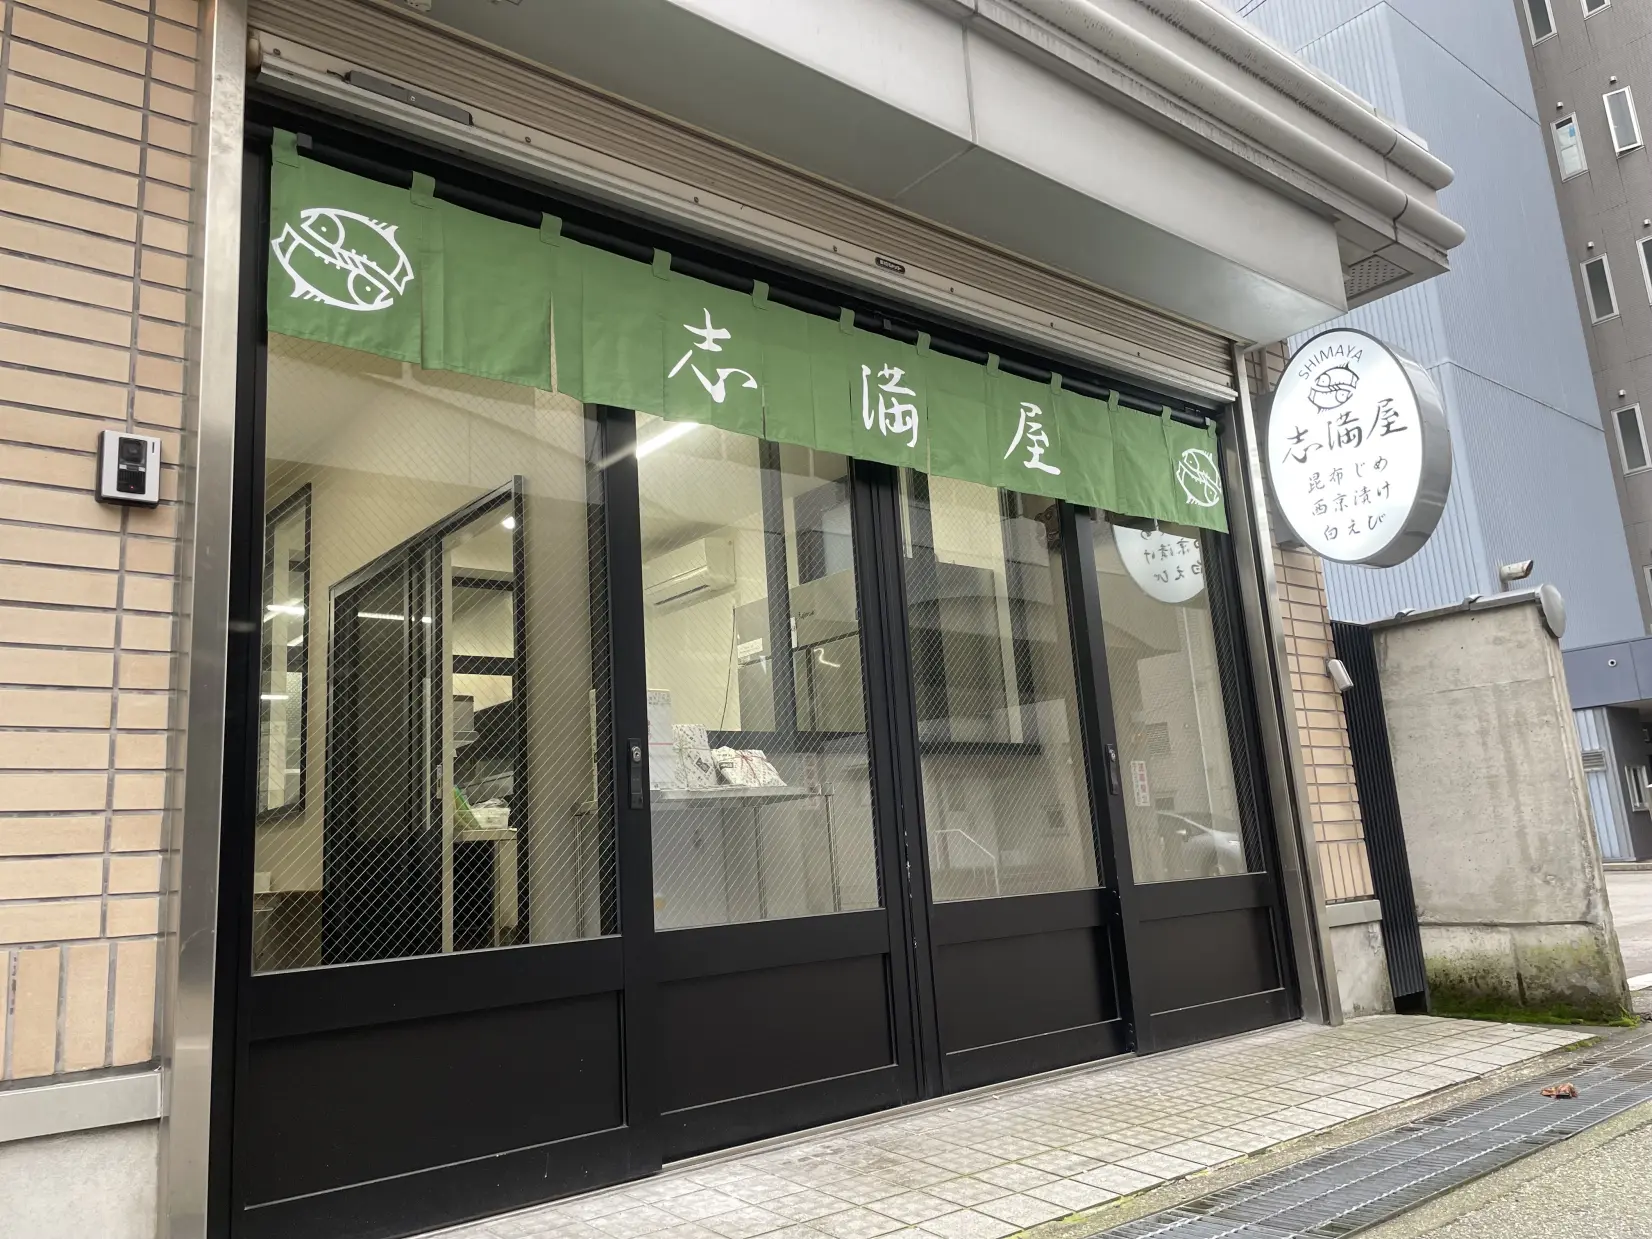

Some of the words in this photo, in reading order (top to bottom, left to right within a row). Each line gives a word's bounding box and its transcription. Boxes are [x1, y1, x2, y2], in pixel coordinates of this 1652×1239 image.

[1298, 344, 1363, 380] SHIMAYA
[668, 307, 1061, 475] 志満屋
[1282, 398, 1408, 463] 志満屋
[1307, 455, 1388, 494] 昆布じめ
[1311, 481, 1391, 516] 西京漬け
[1323, 513, 1386, 541] 白えび
